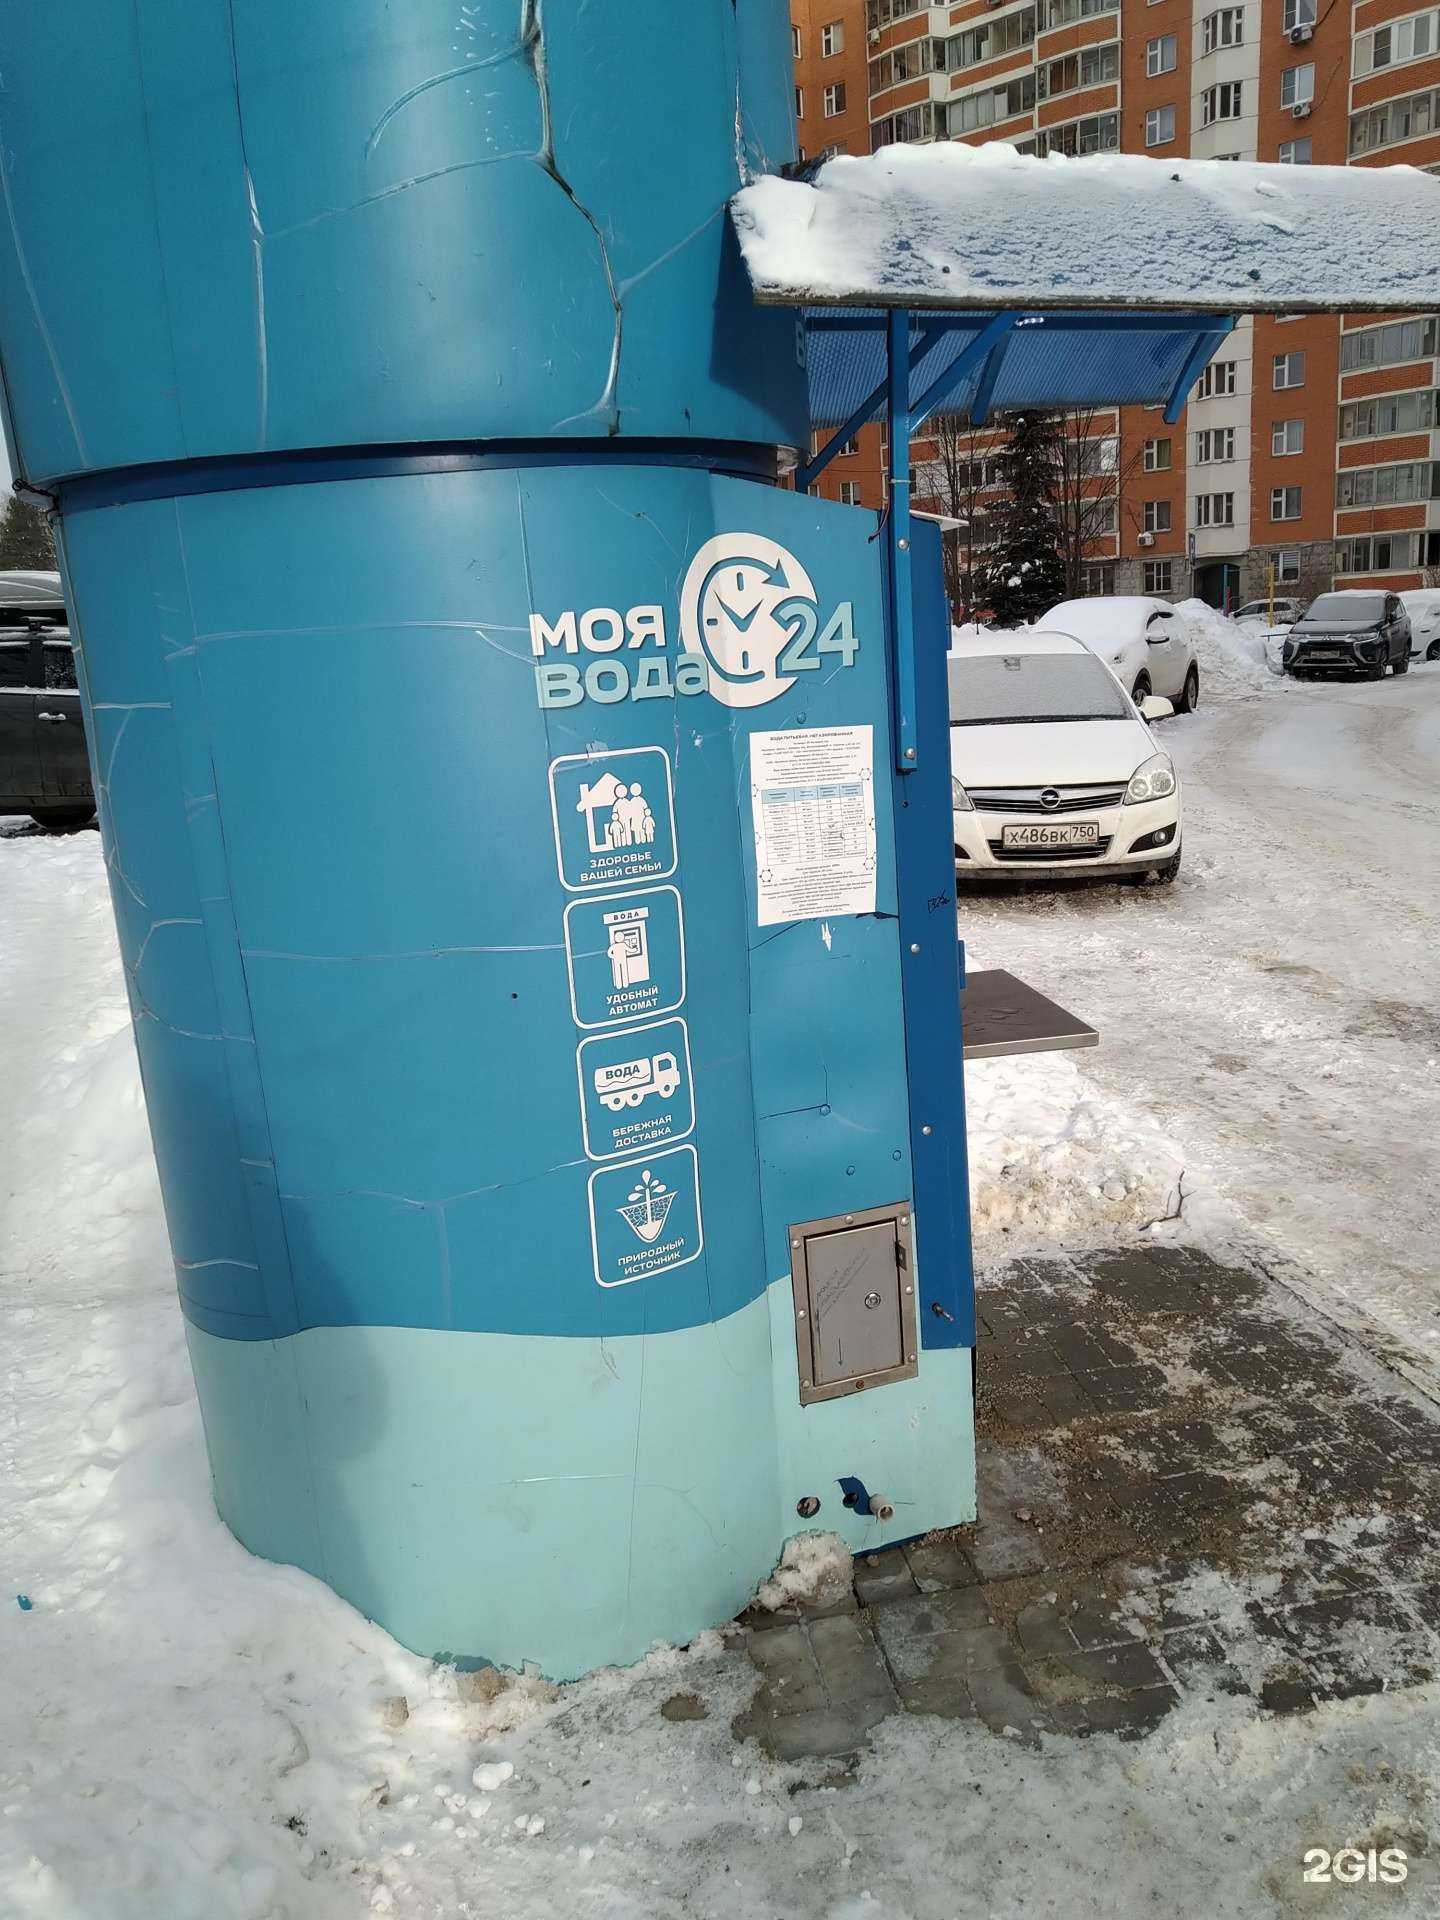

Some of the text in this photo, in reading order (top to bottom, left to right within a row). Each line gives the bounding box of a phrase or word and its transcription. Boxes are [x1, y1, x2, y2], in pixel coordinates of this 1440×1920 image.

[778, 601, 859, 671] 24
[1072, 826, 1094, 838] 750
[590, 851, 652, 868] ЗДОРОВЬЕ
[580, 861, 661, 881] ВАШЕЙ СЕМЬИ
[613, 911, 639, 921] ВОДА
[606, 985, 658, 1004] УДОБНЫЙ
[609, 998, 658, 1015] АВТОМАТ
[605, 1064, 640, 1080] ВОДА
[612, 1114, 672, 1138] БЕРЕЖНАЯ
[615, 1126, 672, 1149] ДОСТАВКА
[618, 1236, 685, 1266] ПРИРОДНЫЙ
[624, 1251, 681, 1275] ИСТОЧНИК
